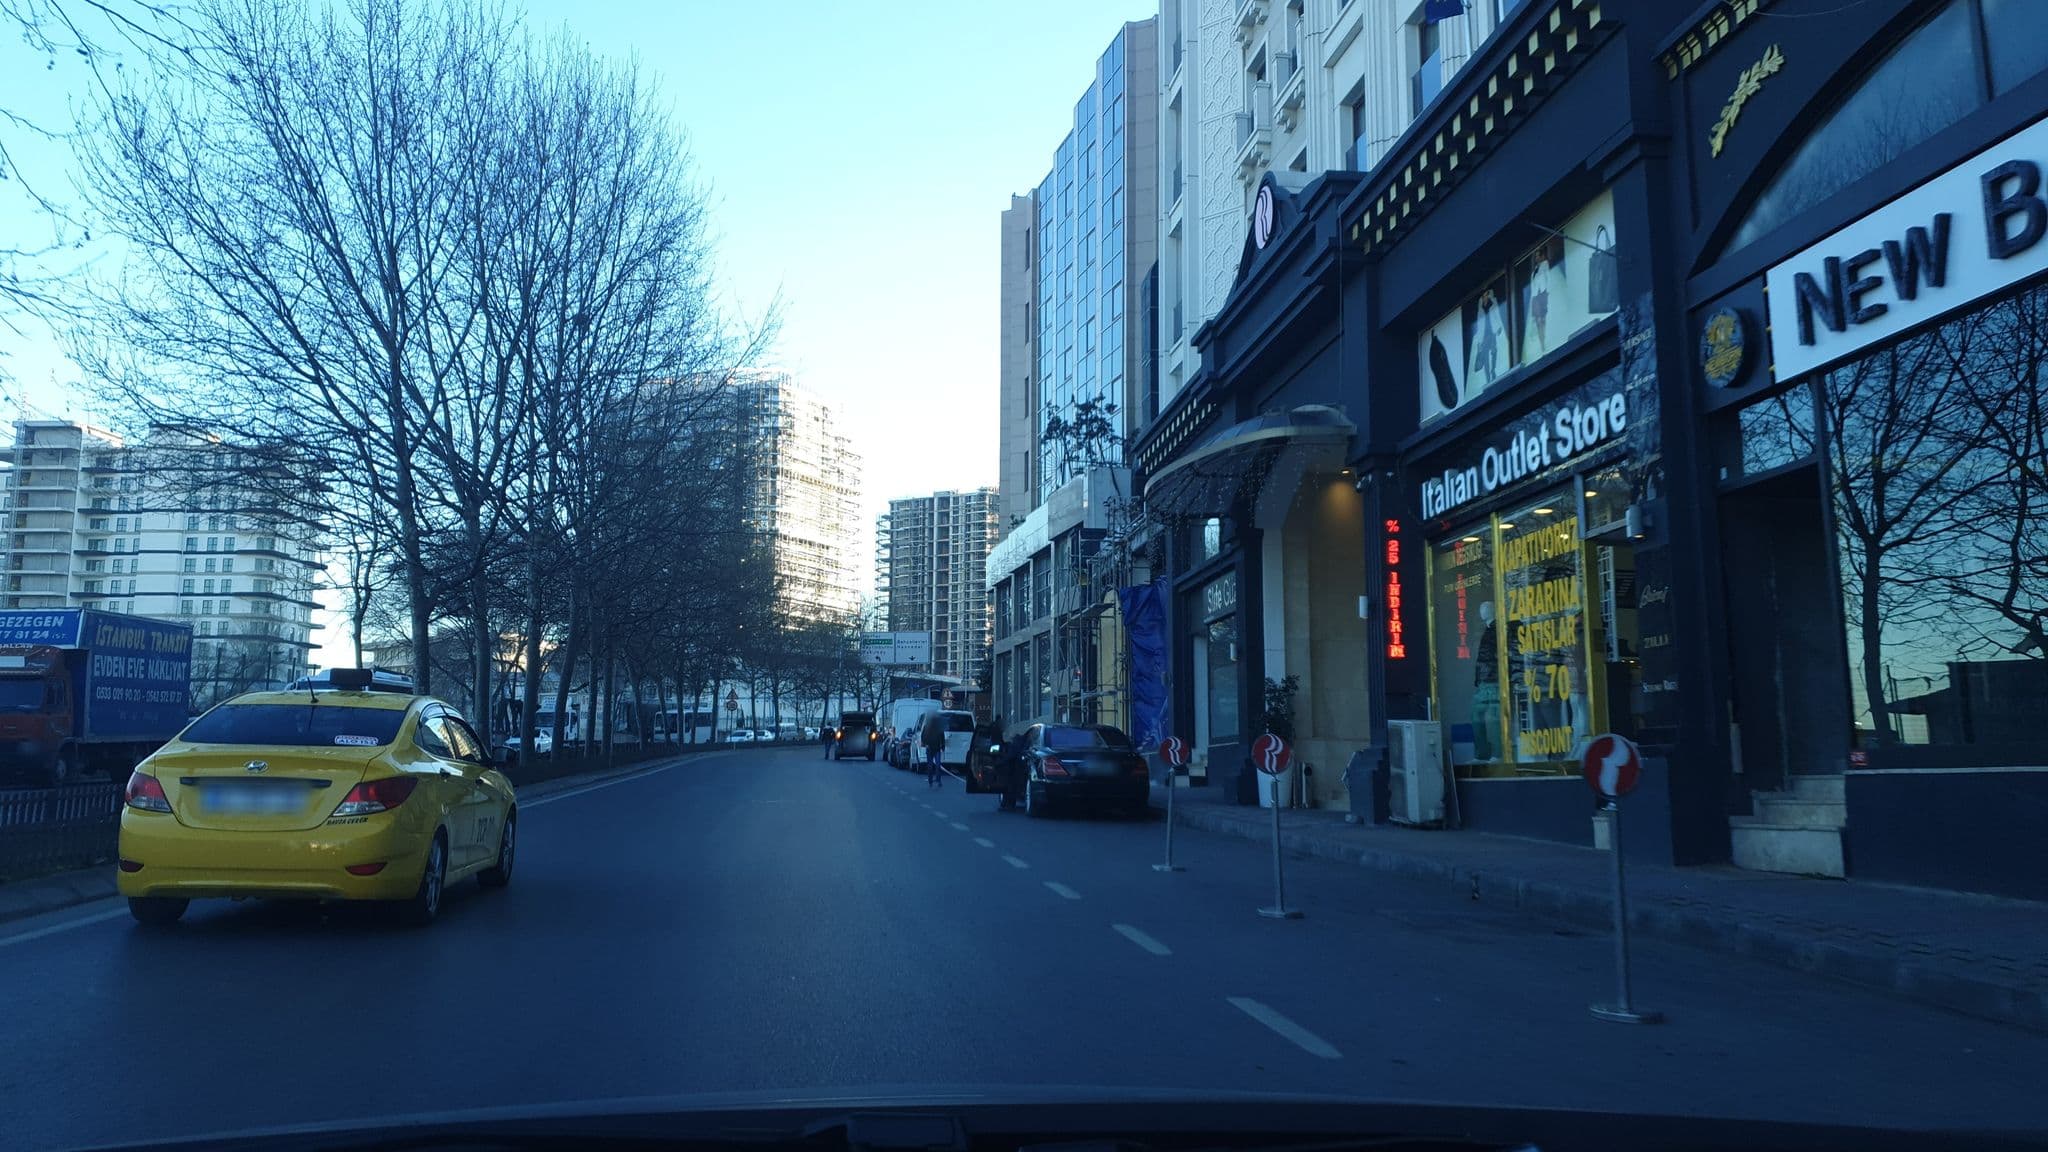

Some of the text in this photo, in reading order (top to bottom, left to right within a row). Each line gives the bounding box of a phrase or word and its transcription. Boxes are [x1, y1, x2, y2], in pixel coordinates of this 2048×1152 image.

[1794, 160, 2048, 346] NEW B
[1422, 393, 1626, 520] Italian Outlet Store
[1386, 519, 1399, 532] %
[1388, 540, 1399, 564] 25
[1500, 515, 1579, 573] KAPATIYORUZ
[1508, 575, 1580, 621] ZARARINA
[15, 630, 29, 639] 81
[32, 630, 49, 639] 24
[96, 624, 145, 650] İSTANBUL
[94, 655, 125, 678] EVDEN
[127, 657, 144, 679] EVE
[1524, 664, 1571, 702] % 70
